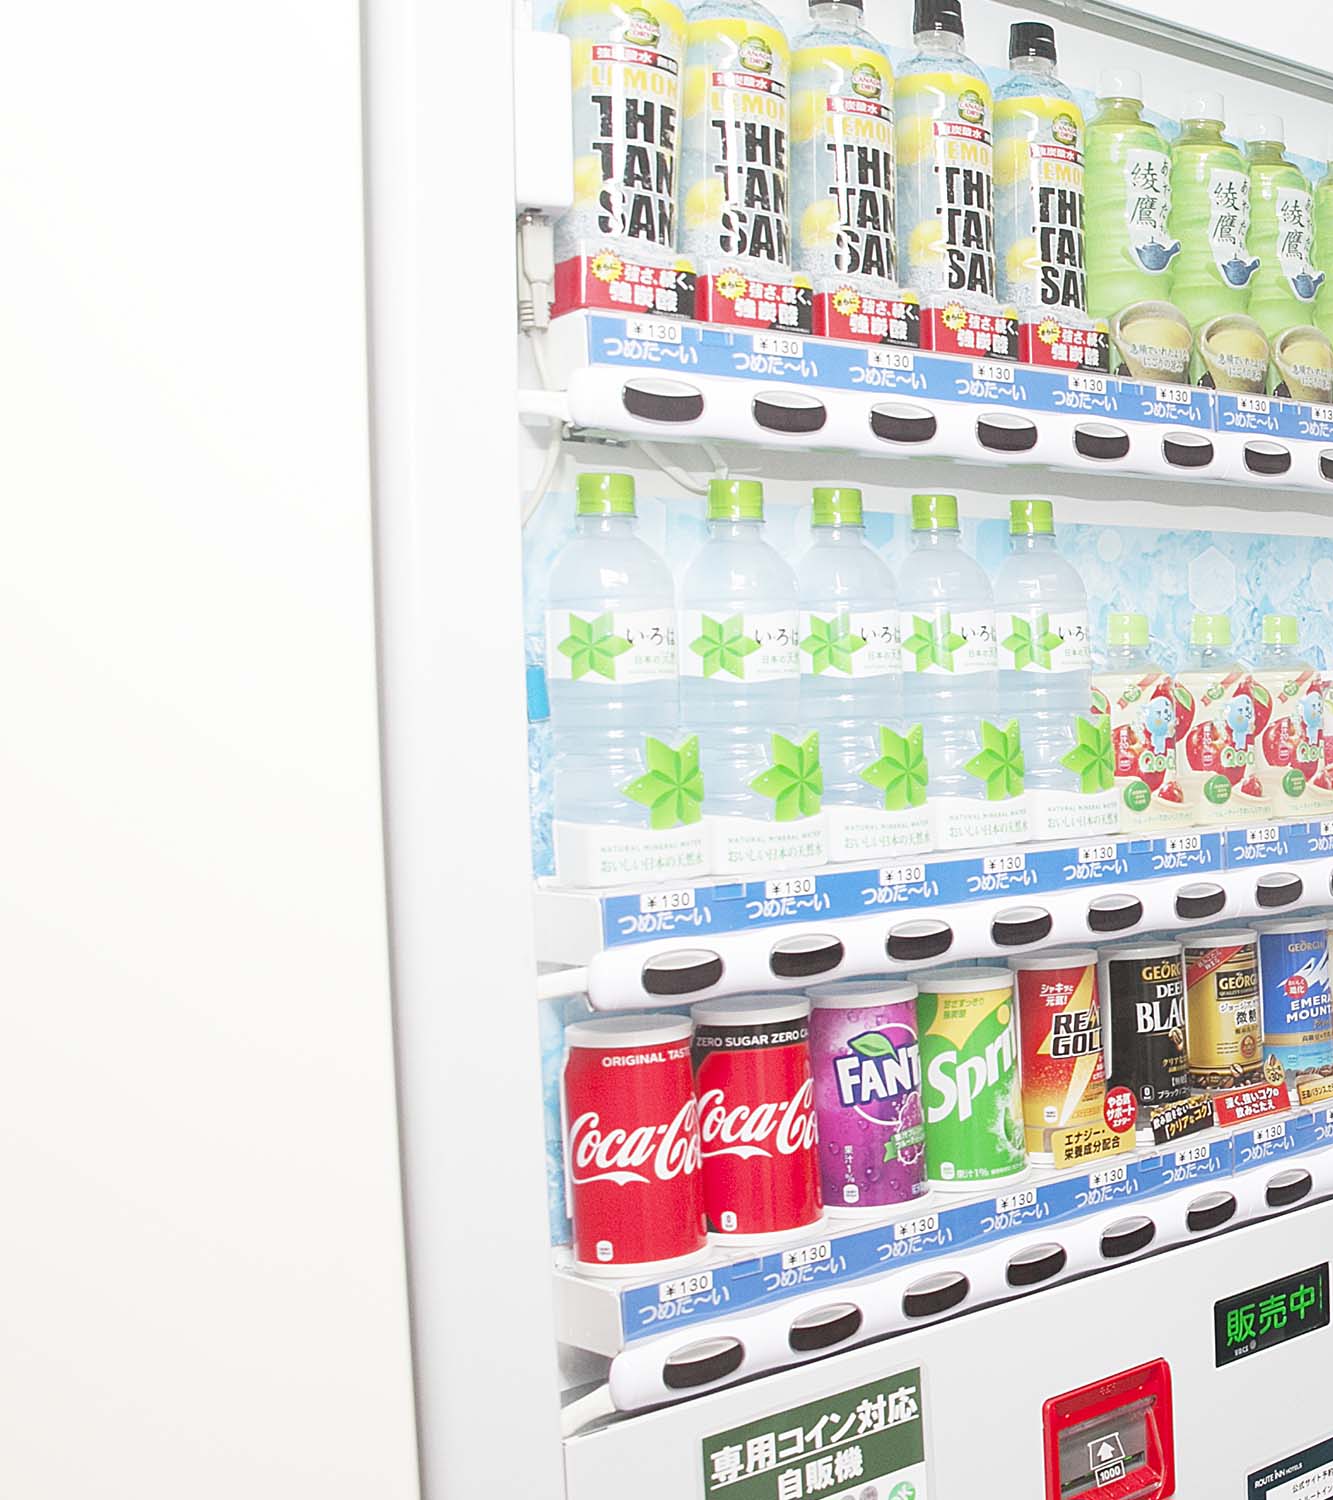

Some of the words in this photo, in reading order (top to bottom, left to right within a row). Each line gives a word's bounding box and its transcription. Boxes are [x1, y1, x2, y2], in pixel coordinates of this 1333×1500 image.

[1130, 161, 1161, 229] 綾鷹
[1212, 181, 1241, 245] 綾鷹
[1279, 199, 1306, 260] 綾鷹
[602, 1051, 665, 1068] ORIGINAL
[696, 1036, 722, 1048] ZERO
[725, 1033, 769, 1047] SUGAR
[771, 1029, 800, 1045] ZERO
[1064, 1136, 1121, 1161] 栄養成分配合
[1225, 1283, 1315, 1347] 販売中
[710, 1386, 919, 1484] 専用コイン対応
[777, 1445, 865, 1500] 自販機
[1099, 1465, 1121, 1482] 1000
[1254, 1474, 1275, 1489] ROUTE
